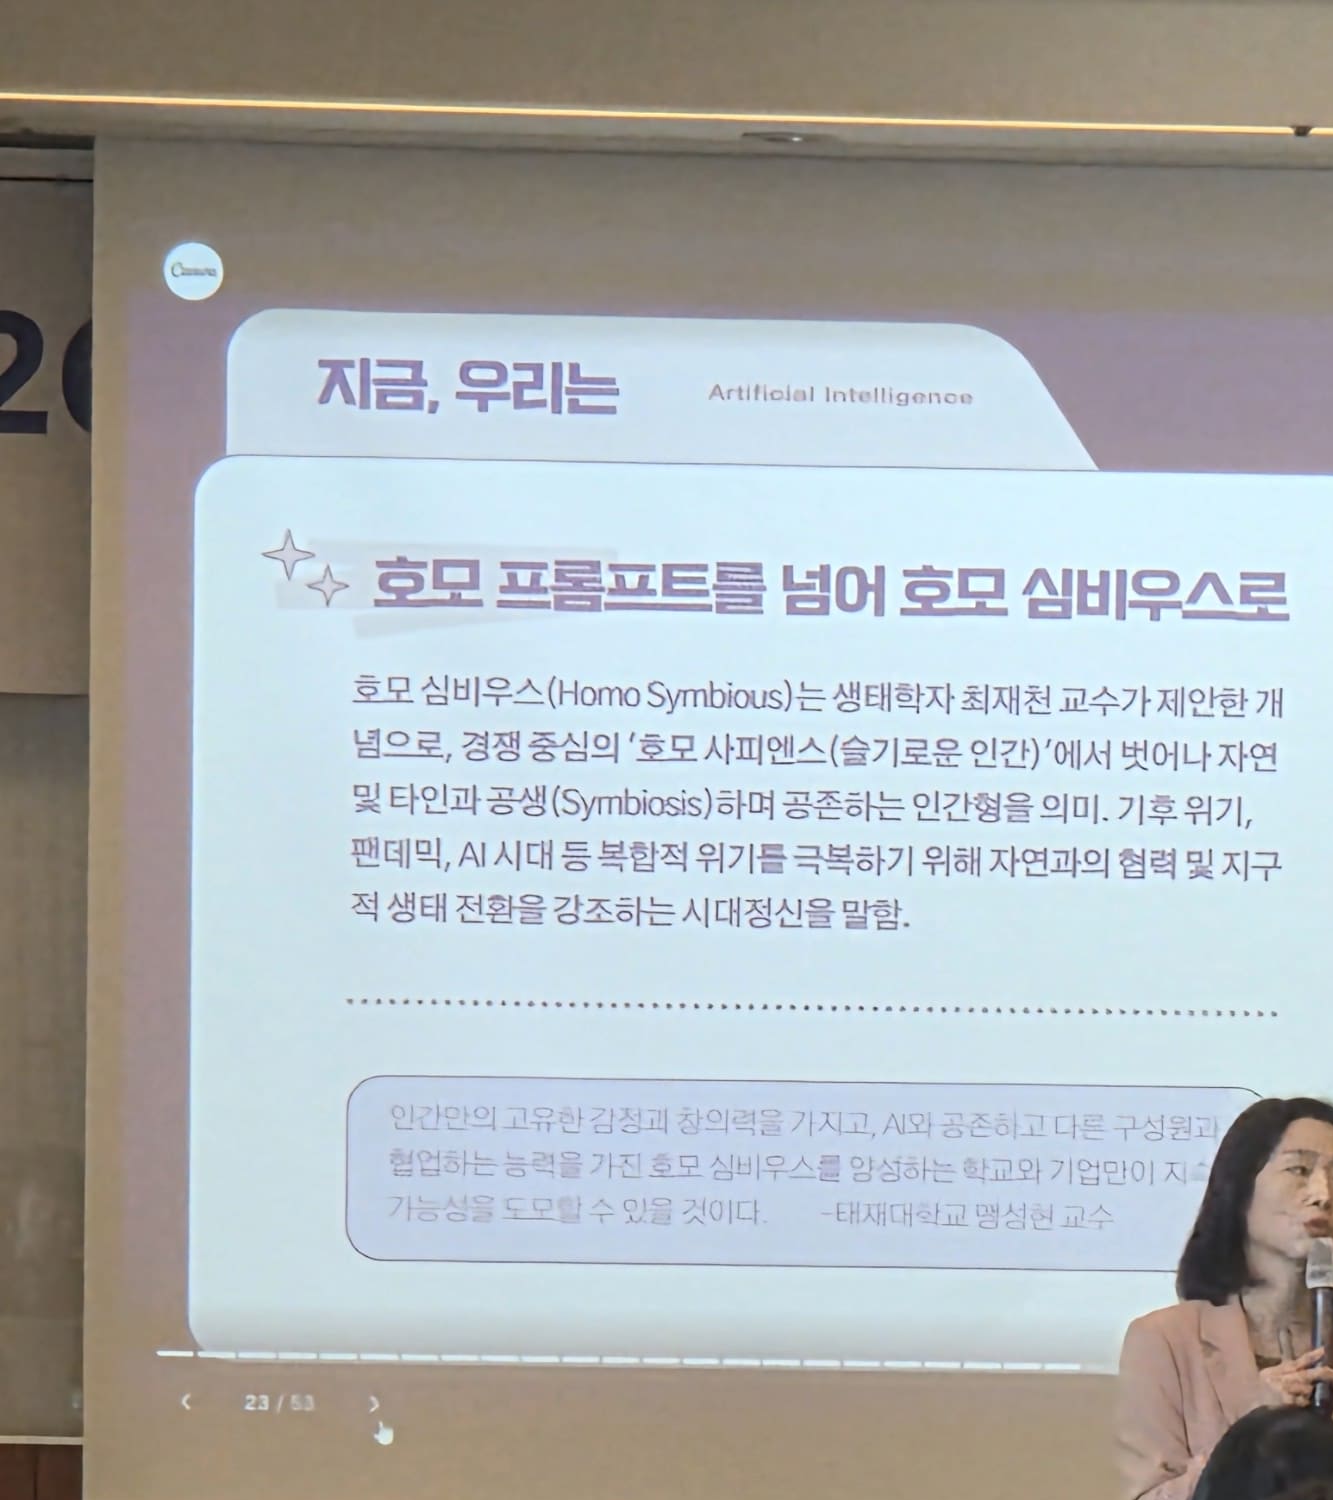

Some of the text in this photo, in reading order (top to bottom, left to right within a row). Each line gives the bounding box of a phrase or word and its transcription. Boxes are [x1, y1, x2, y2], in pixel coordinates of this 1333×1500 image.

[317, 357, 620, 416] 지금, 우리는
[708, 383, 973, 407] Artificial Intelligence
[373, 555, 1291, 622] 호모 프롬프트를 넘어 호모 심비우스로
[352, 672, 414, 704] 호모
[831, 680, 956, 716] 생태학자
[960, 683, 1052, 717] 최재천
[1058, 684, 1152, 719] 교수가
[1156, 685, 1249, 719] 제안한
[1255, 687, 1284, 719] 개
[352, 726, 452, 763] 념으로,
[461, 730, 521, 763] 경쟁
[527, 730, 620, 765] 중심의
[1121, 739, 1213, 773] 벗어나
[1217, 740, 1278, 774] 자연
[352, 781, 1253, 830] 및 타인과 공생(Symbiosis)하며 공존하는 인간형을 의미. 기후 위기,
[350, 836, 1283, 883] 팬데믹, AI 시대 등 복합적 위기를 극복하기 위해 자연과의 협력 및 지구
[351, 890, 911, 932] 적 생태 전환을 강조하는 시대정신을 말함.
[243, 1394, 270, 1412] 23
